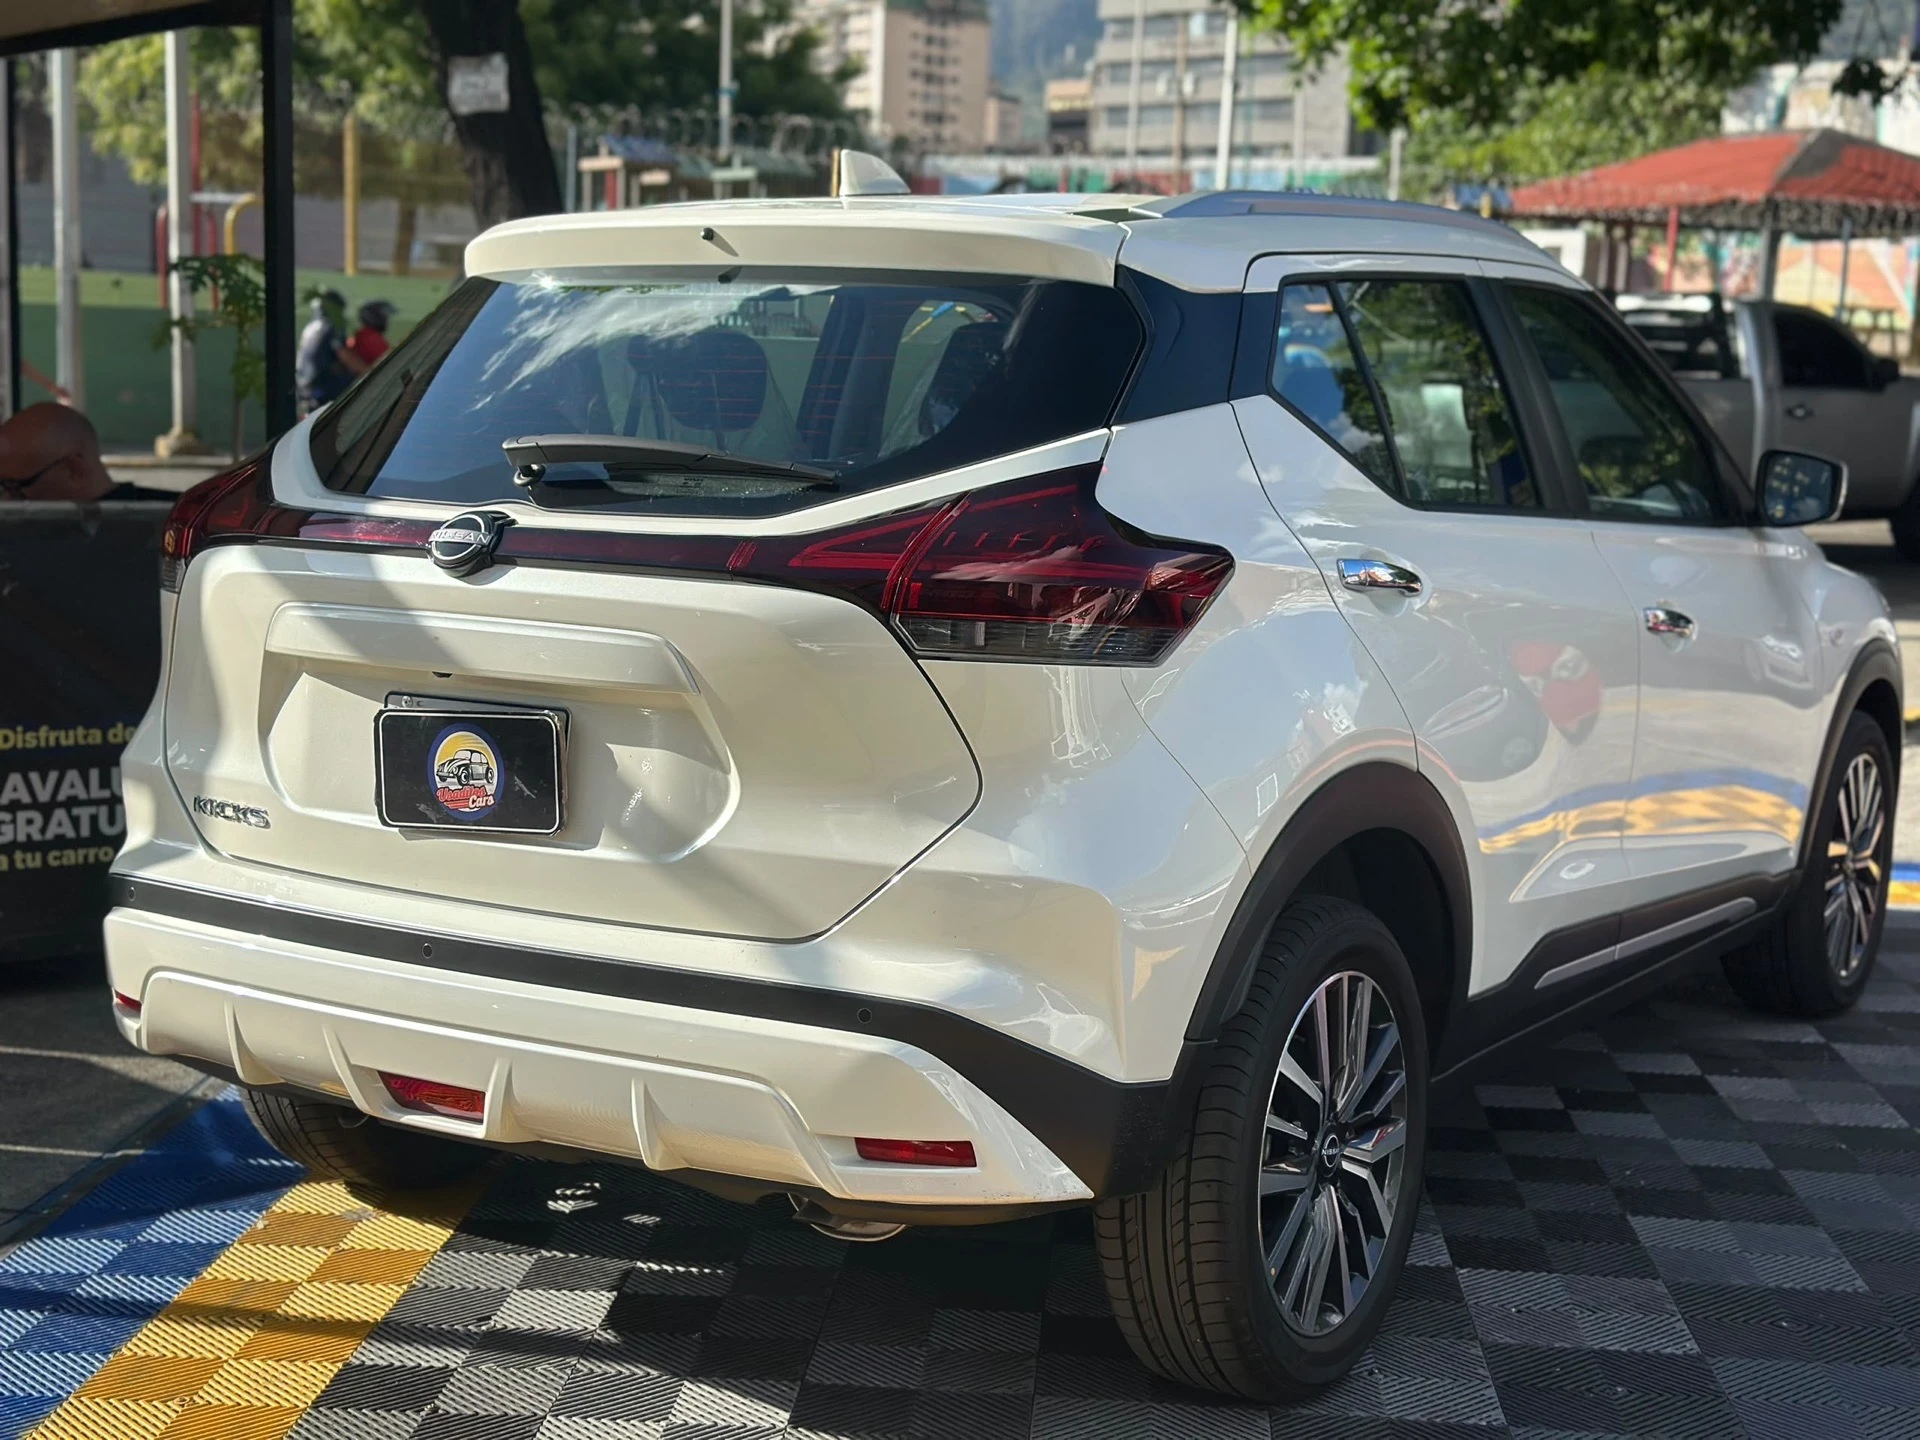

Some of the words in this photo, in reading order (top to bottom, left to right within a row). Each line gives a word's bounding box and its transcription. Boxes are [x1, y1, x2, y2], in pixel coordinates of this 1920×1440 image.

[429, 529, 490, 547] NISSAN
[0, 725, 103, 749] Disfruta
[193, 796, 271, 829] KICKS
[469, 795, 495, 809] Cars
[14, 850, 42, 870] tu
[47, 846, 115, 867] carro
